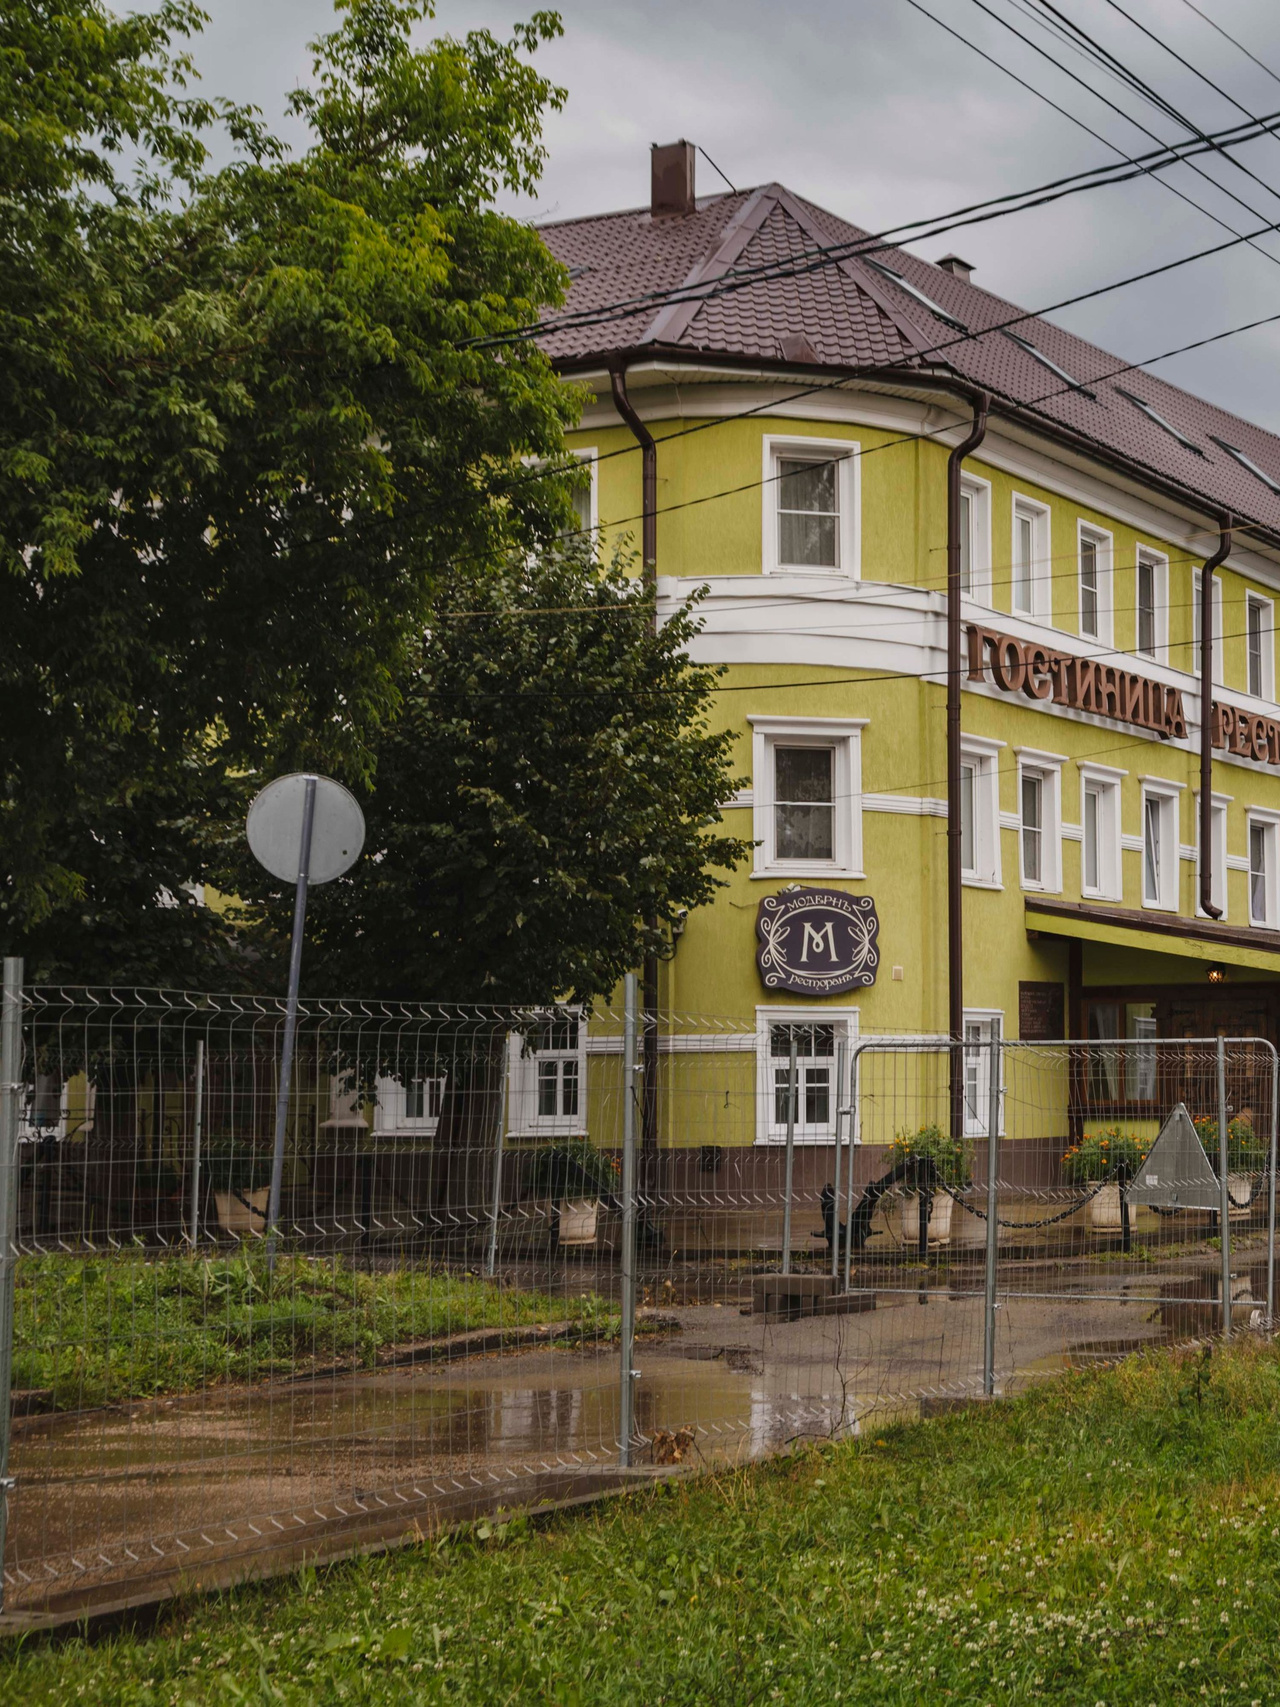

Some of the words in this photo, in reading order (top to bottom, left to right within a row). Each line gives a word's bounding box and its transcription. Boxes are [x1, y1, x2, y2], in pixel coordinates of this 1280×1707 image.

[967, 625, 1188, 739] ГОСТИНИЦА
[787, 895, 852, 912] МОДЕРНЪ
[787, 973, 853, 990] ресторанъ
